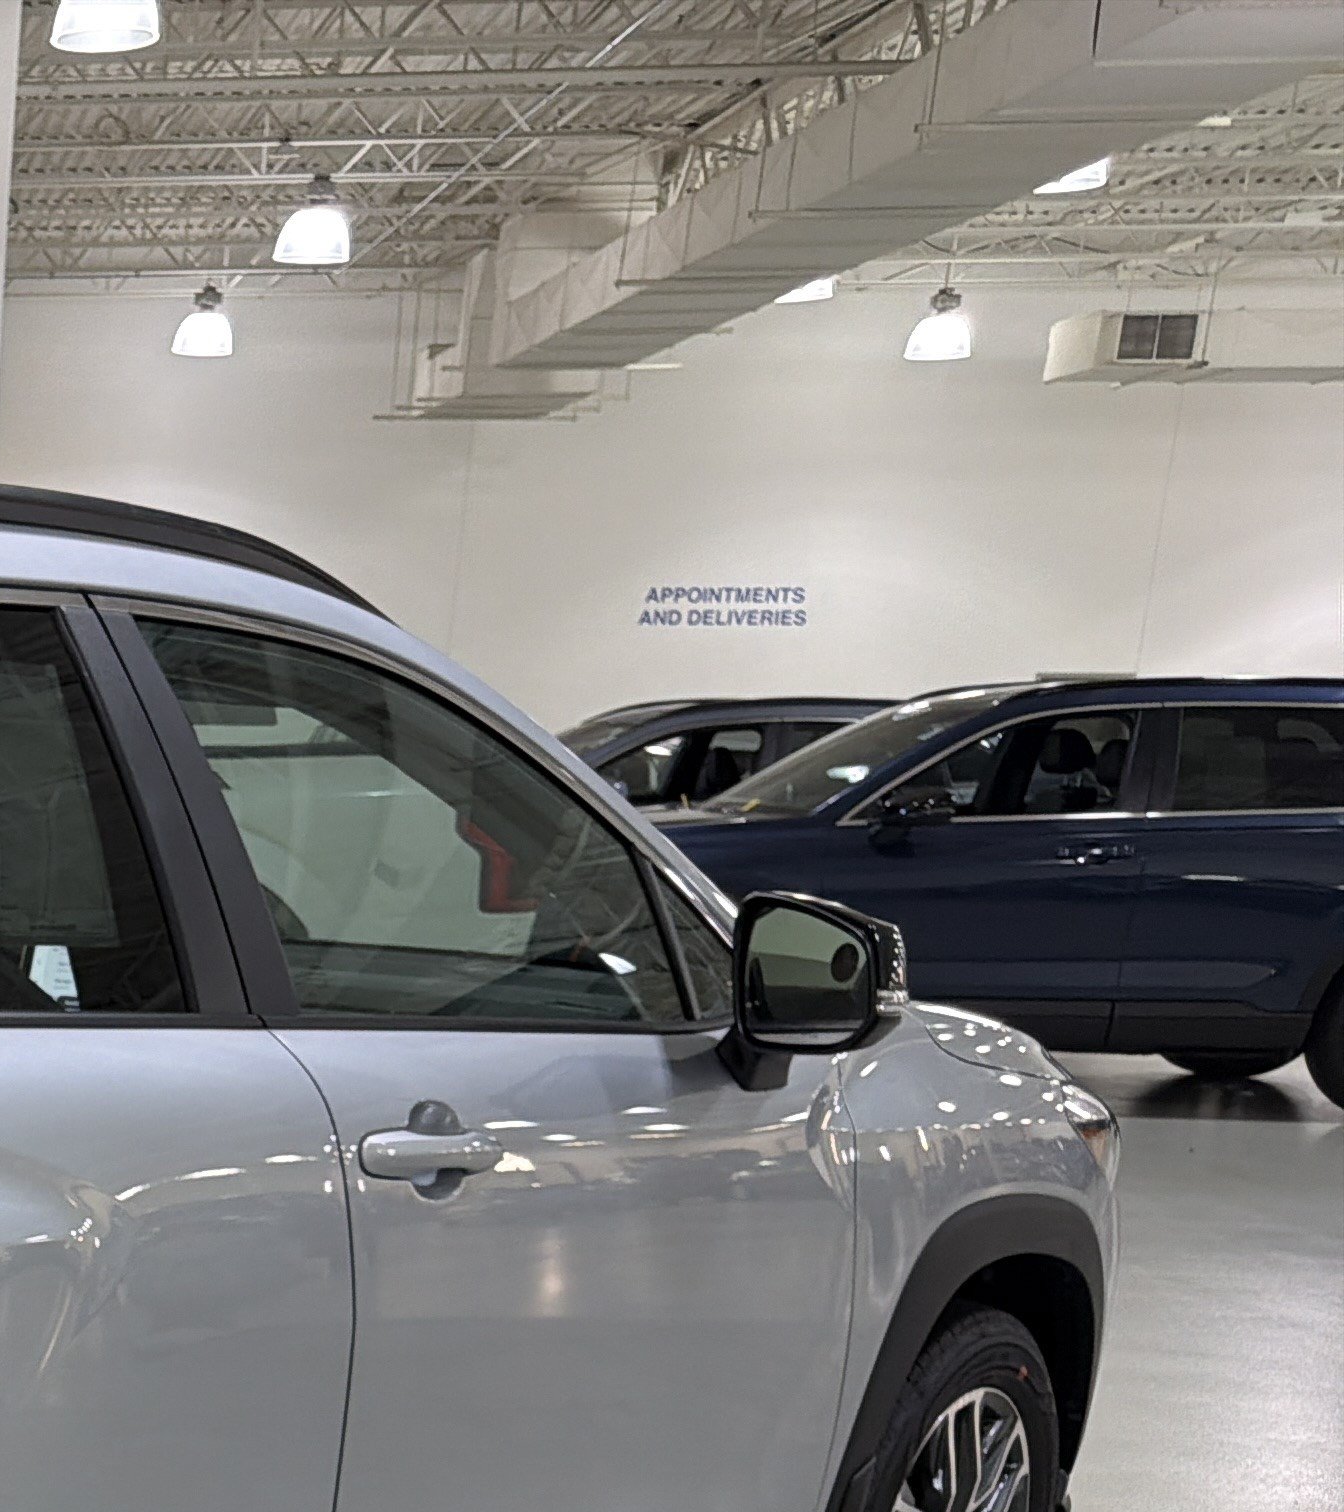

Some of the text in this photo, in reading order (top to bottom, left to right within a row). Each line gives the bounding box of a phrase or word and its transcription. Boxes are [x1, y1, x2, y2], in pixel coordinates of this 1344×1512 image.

[644, 585, 807, 604] APPOINTMENTS
[638, 608, 808, 627] AND DELIVERIES
